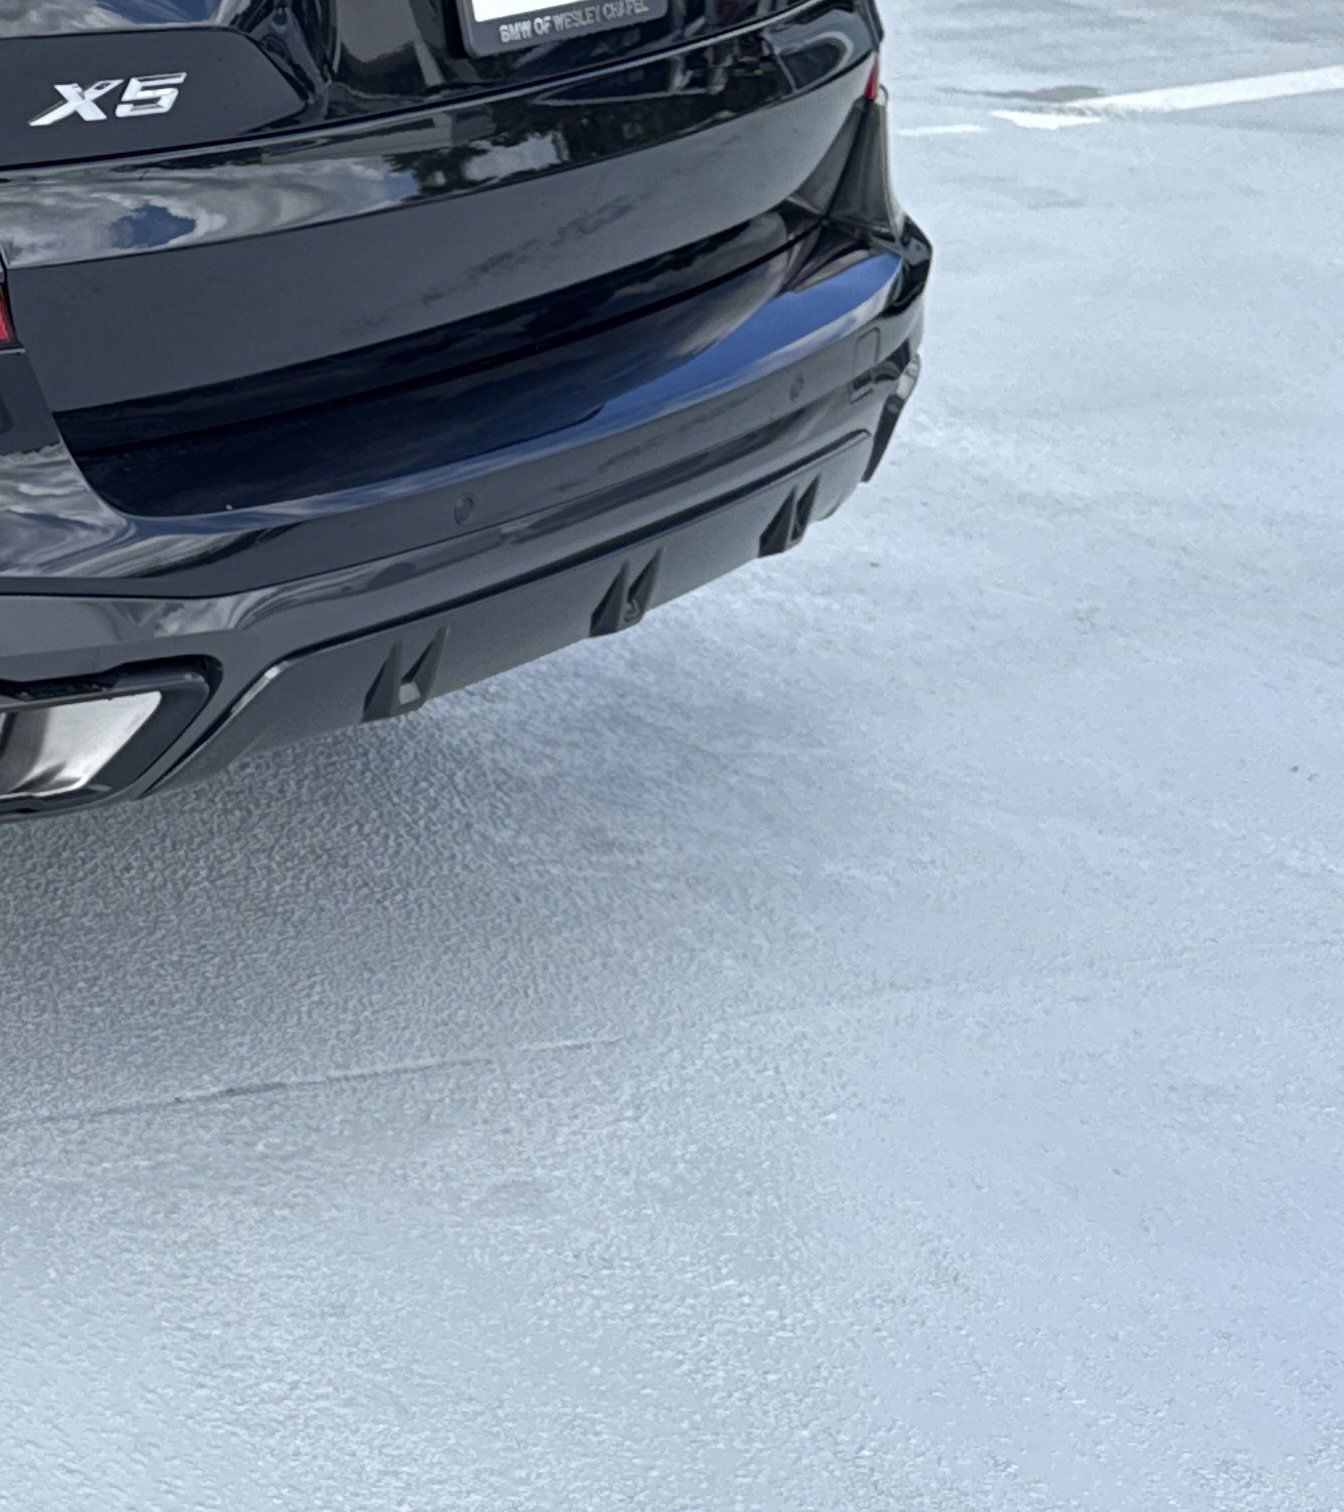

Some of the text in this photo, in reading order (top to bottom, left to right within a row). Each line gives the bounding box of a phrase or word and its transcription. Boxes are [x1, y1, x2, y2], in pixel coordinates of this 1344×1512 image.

[499, 20, 532, 43] BMW
[534, 16, 552, 36] OF
[552, 4, 601, 31] WESLEY
[28, 72, 188, 127] X5
